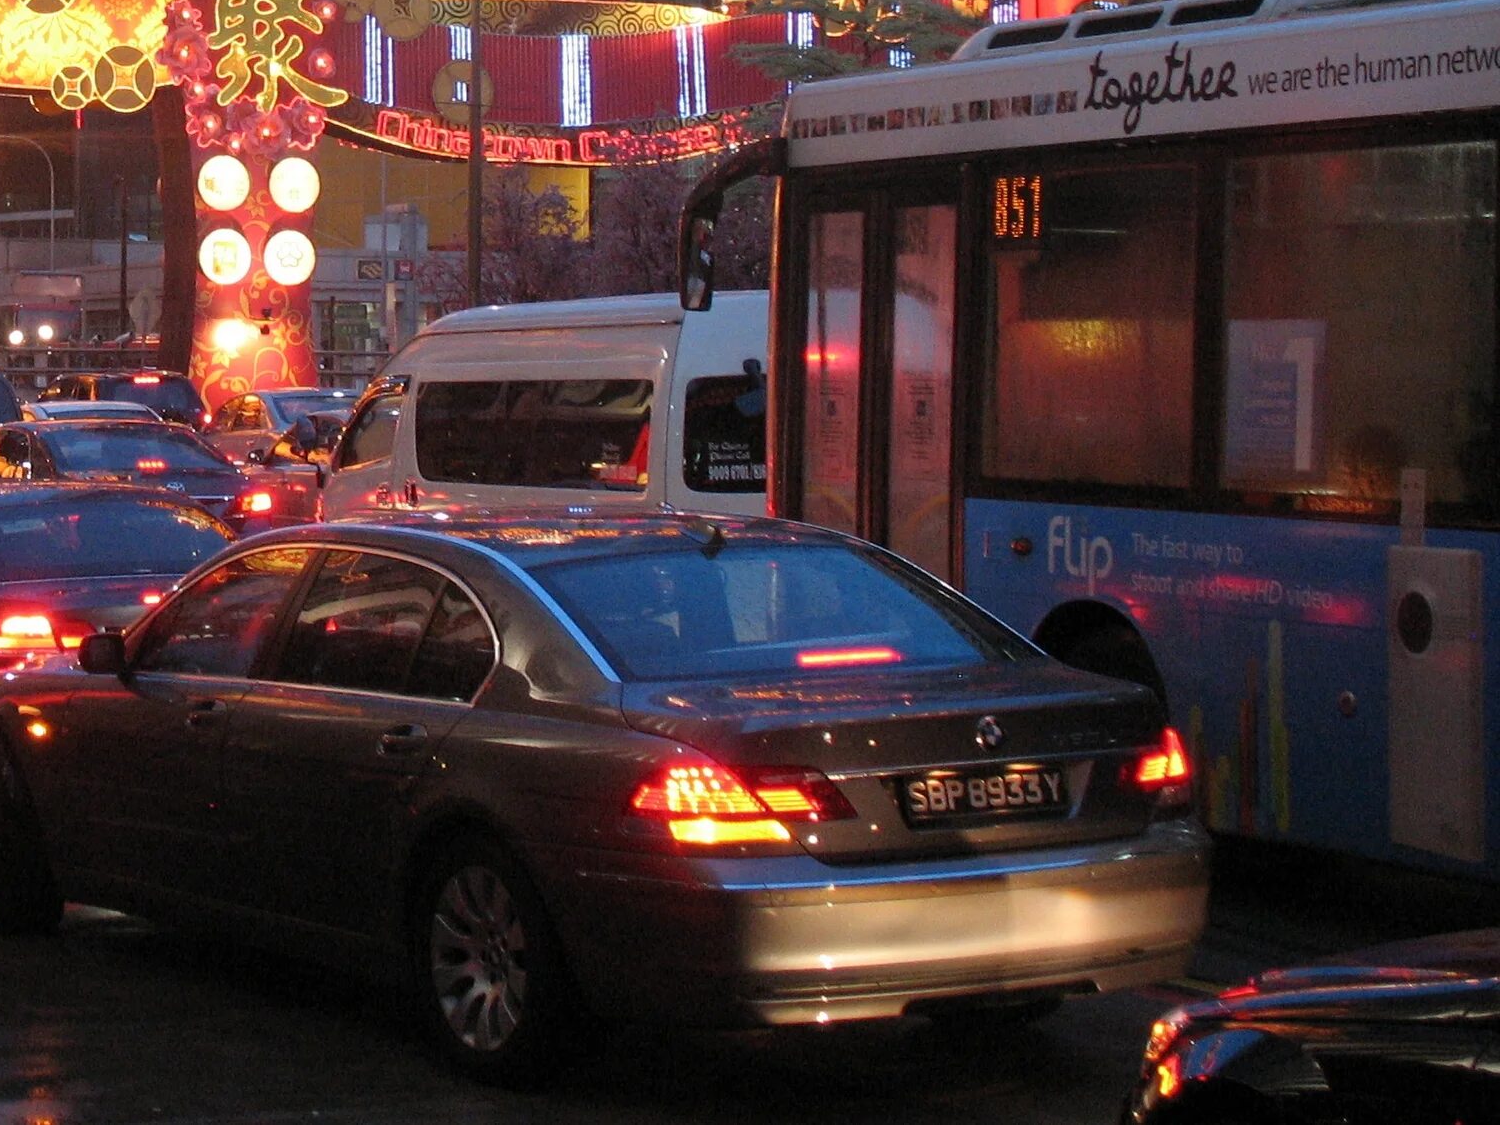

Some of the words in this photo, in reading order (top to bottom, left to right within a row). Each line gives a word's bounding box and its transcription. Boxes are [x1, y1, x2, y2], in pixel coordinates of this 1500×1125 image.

[1248, 70, 1278, 94] we
[1281, 67, 1312, 92] are
[1317, 59, 1349, 88] the
[1355, 52, 1431, 83] human
[995, 175, 1041, 238] 851
[1131, 533, 1158, 557] The
[1226, 543, 1244, 564] to
[1257, 581, 1283, 605] HD
